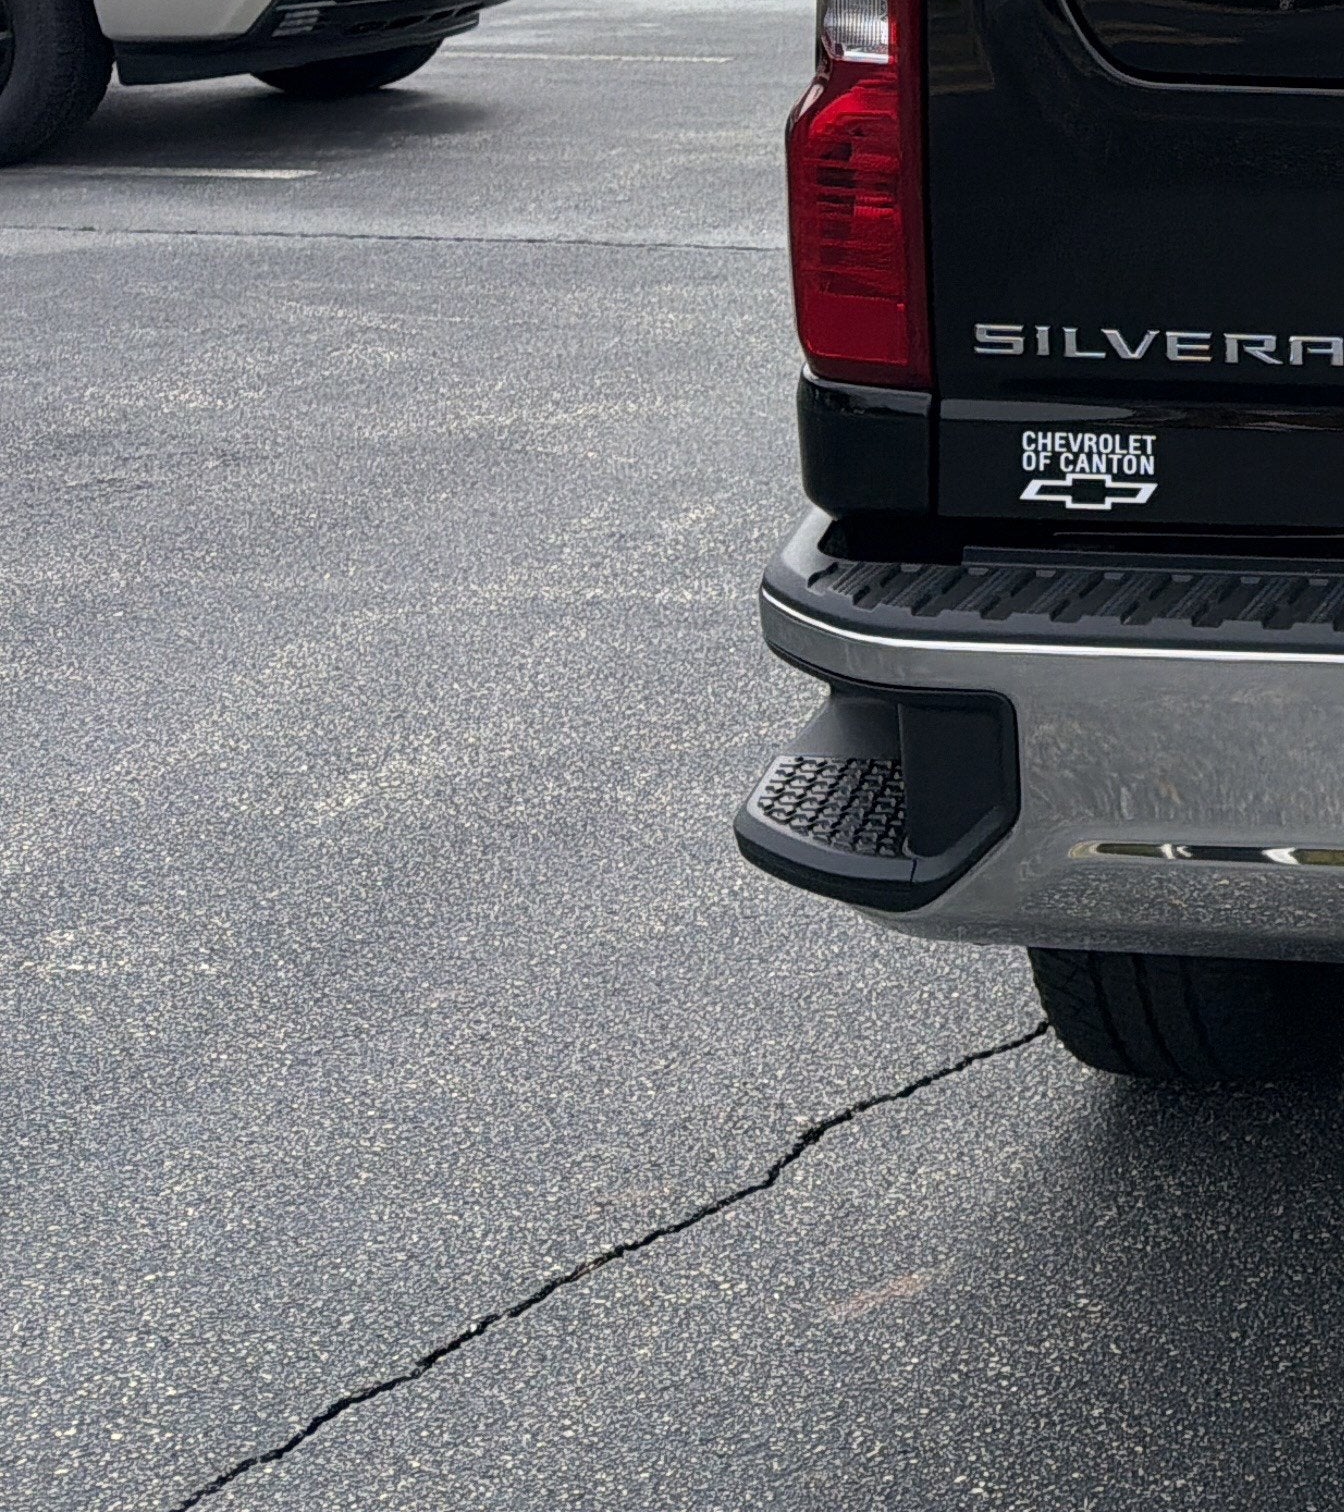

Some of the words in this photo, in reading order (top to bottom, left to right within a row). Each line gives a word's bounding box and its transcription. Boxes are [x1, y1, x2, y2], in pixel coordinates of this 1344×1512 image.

[1022, 430, 1157, 455] CHEVROLET
[1022, 451, 1052, 471] OF
[1059, 452, 1155, 475] CANTON
